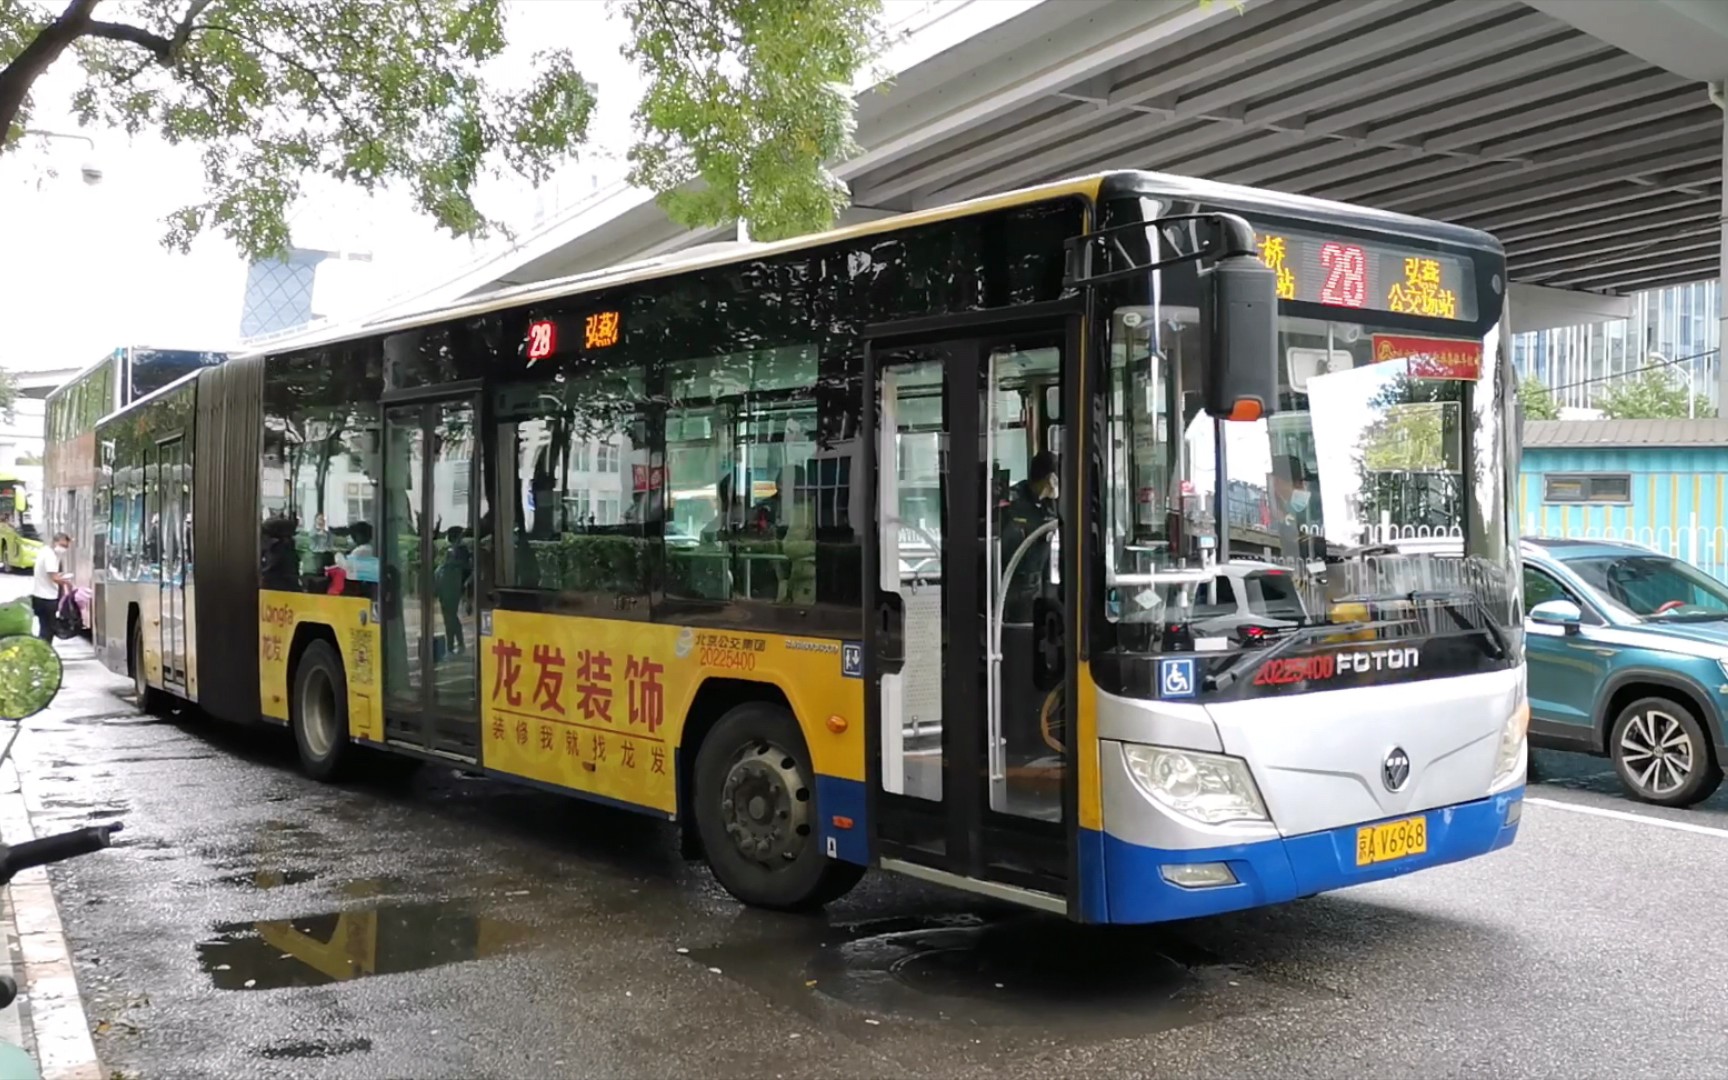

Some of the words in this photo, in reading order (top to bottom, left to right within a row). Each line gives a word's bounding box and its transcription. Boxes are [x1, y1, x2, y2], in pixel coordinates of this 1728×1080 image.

[1253, 233, 1285, 277] 桥
[1320, 243, 1366, 308] 28
[1405, 257, 1441, 291] 弘燕
[1388, 283, 1455, 320] 公交场站
[529, 322, 553, 357] 28
[695, 634, 766, 652] 北京公交集团
[700, 647, 756, 671] 20225400
[1336, 648, 1419, 675] FOTON
[491, 639, 664, 733] 龙发装饰
[492, 715, 666, 776] 装修我就找龙发
